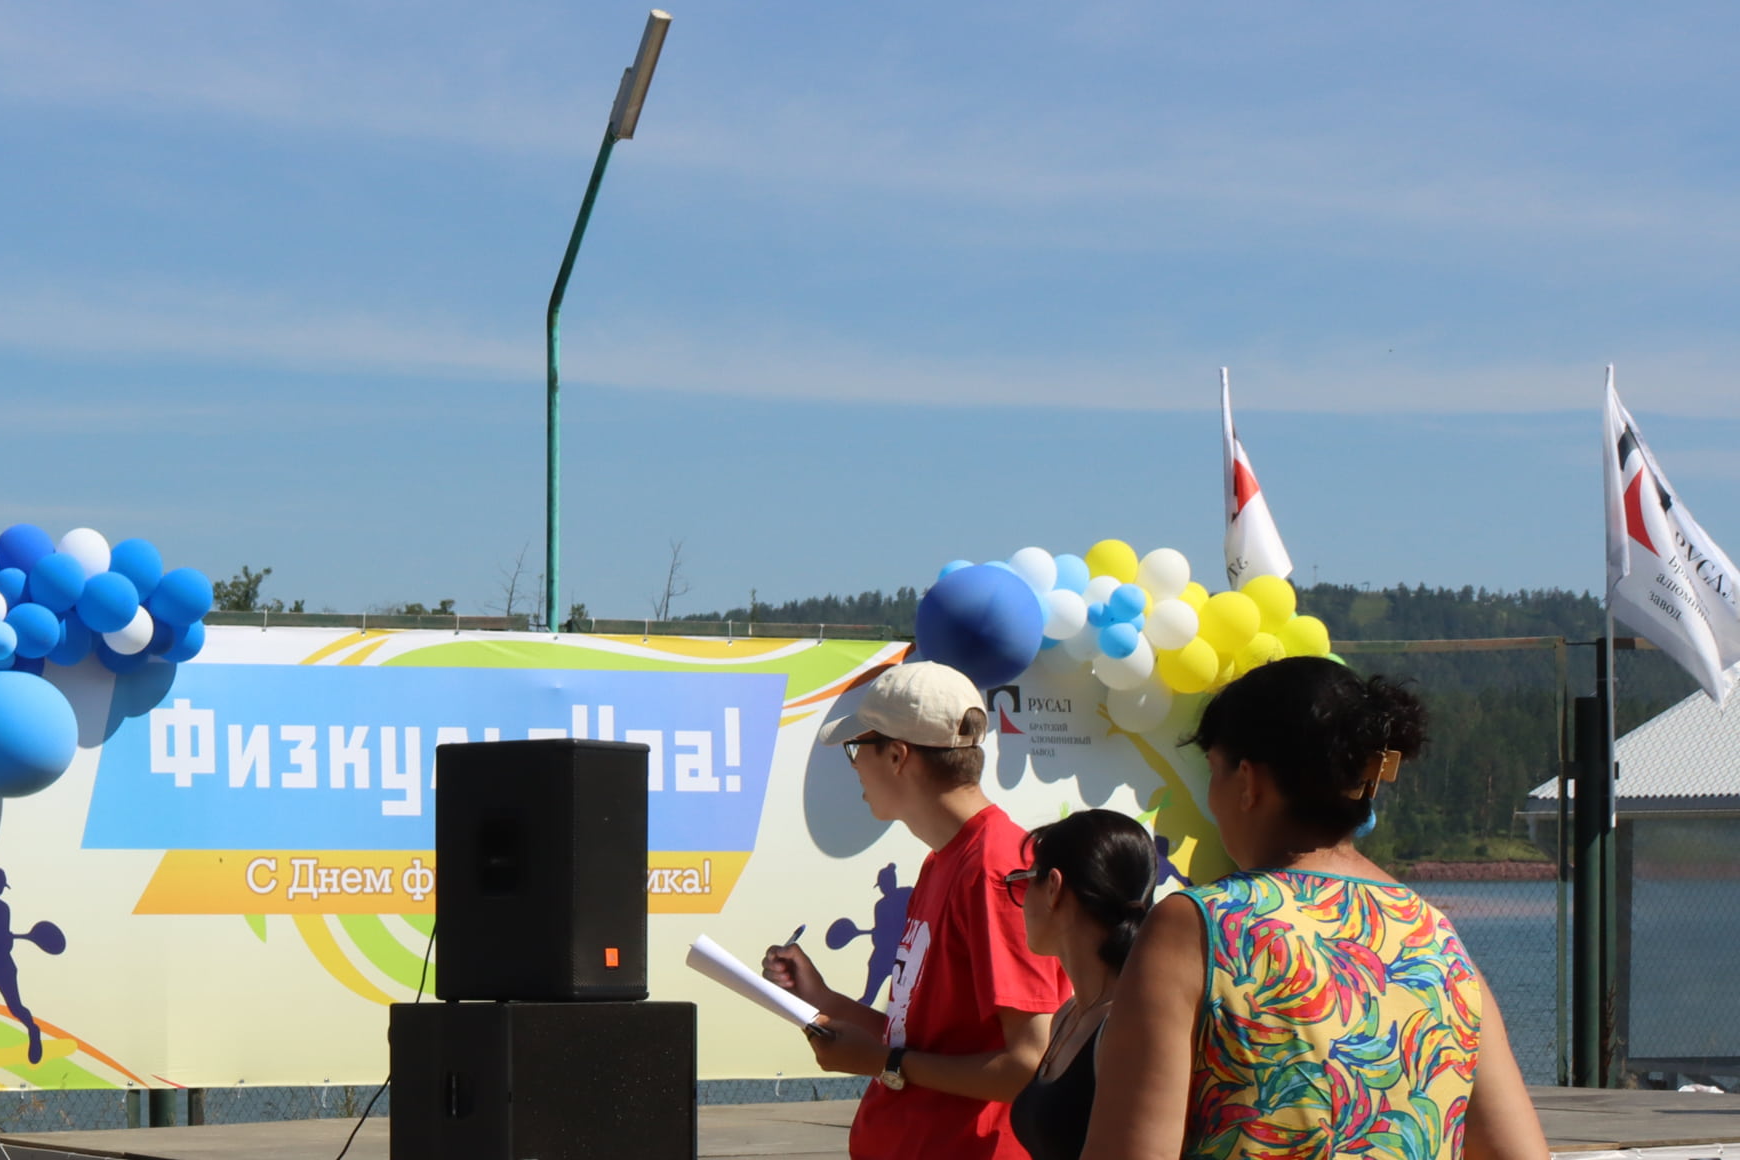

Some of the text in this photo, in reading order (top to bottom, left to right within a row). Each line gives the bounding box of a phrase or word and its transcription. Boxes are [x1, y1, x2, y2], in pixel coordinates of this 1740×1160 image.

[1028, 698, 1072, 713] РУСАЛ
[246, 859, 278, 894] С
[288, 859, 393, 900] Днем
